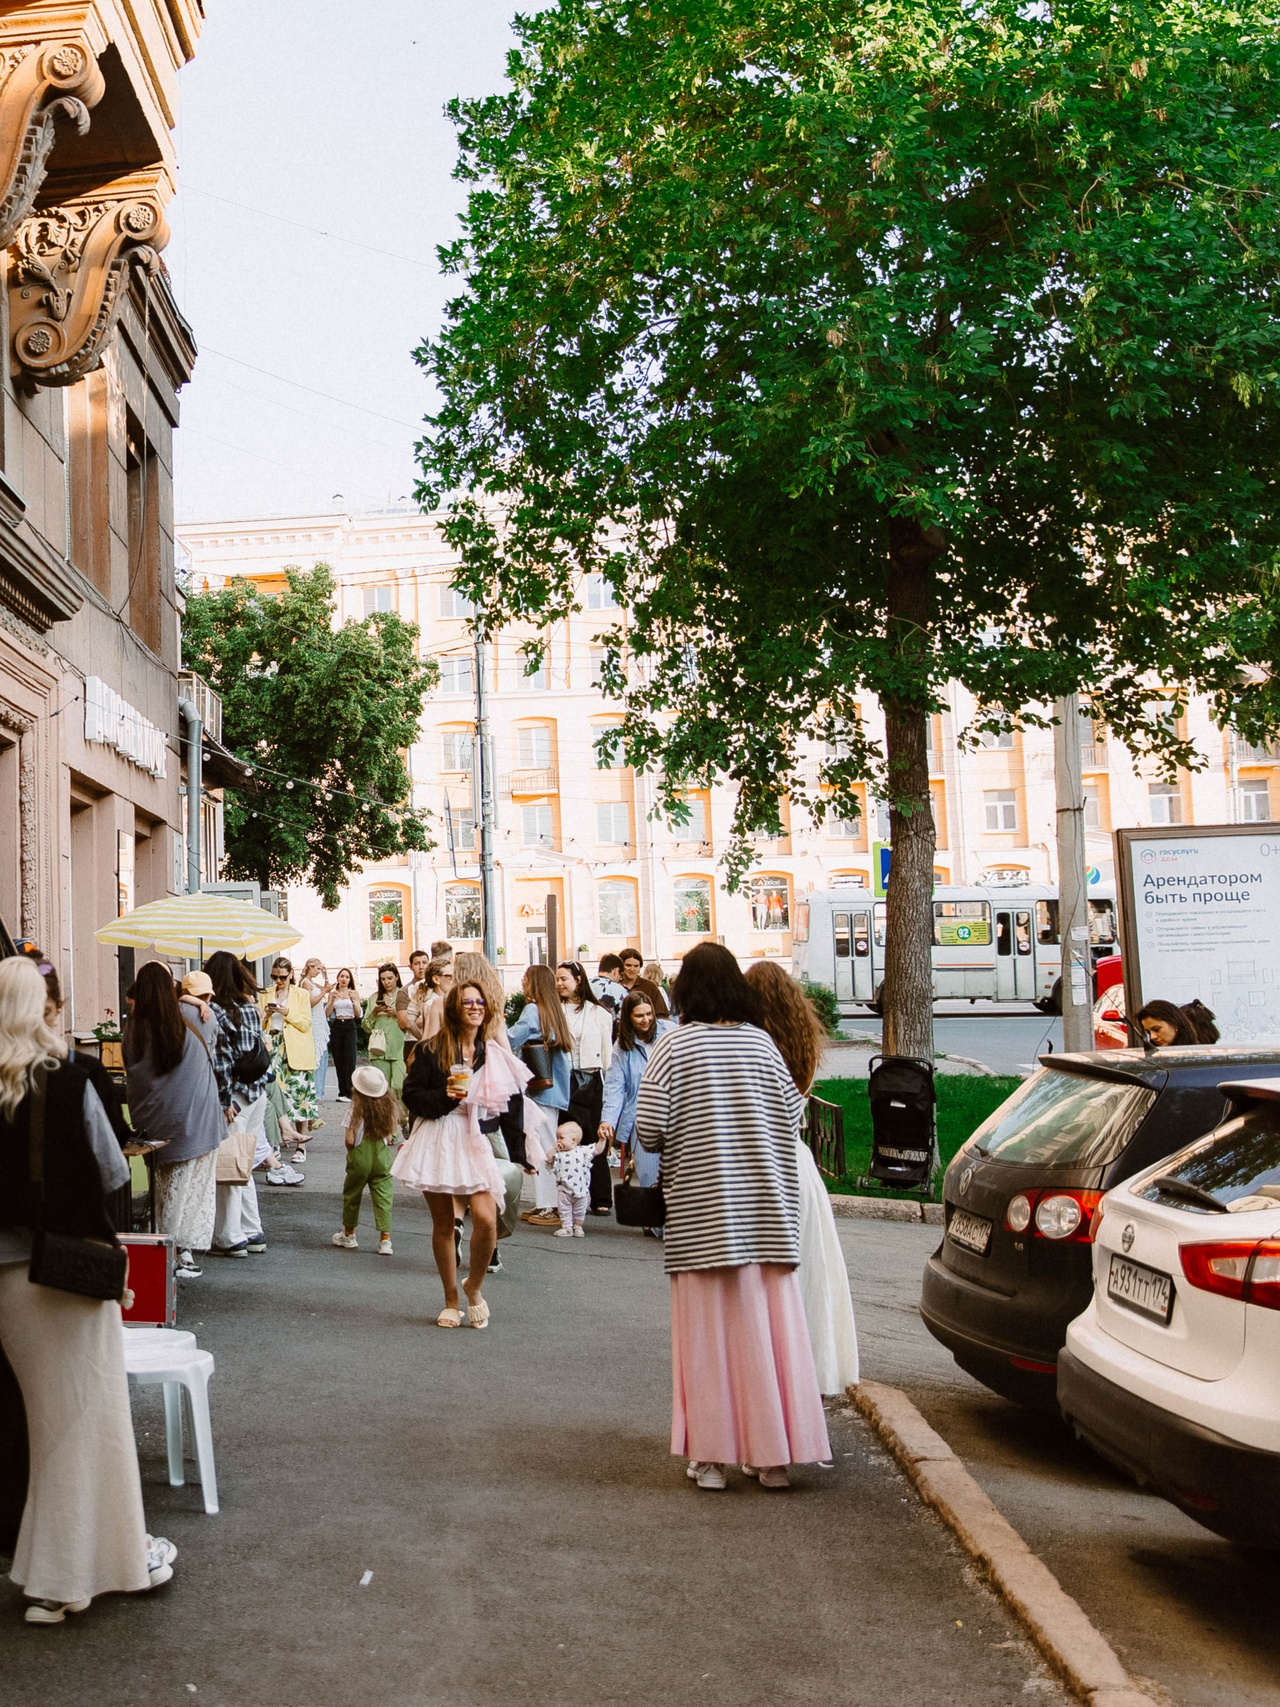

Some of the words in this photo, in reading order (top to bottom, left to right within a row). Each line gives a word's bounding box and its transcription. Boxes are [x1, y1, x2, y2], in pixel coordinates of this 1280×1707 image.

[1260, 843, 1280, 857] 0+
[1143, 873, 1262, 889] Арендатором
[1145, 891, 1187, 904] быть
[1193, 890, 1250, 905] проще
[958, 928, 969, 938] 92
[1152, 1276, 1168, 1304] 174
